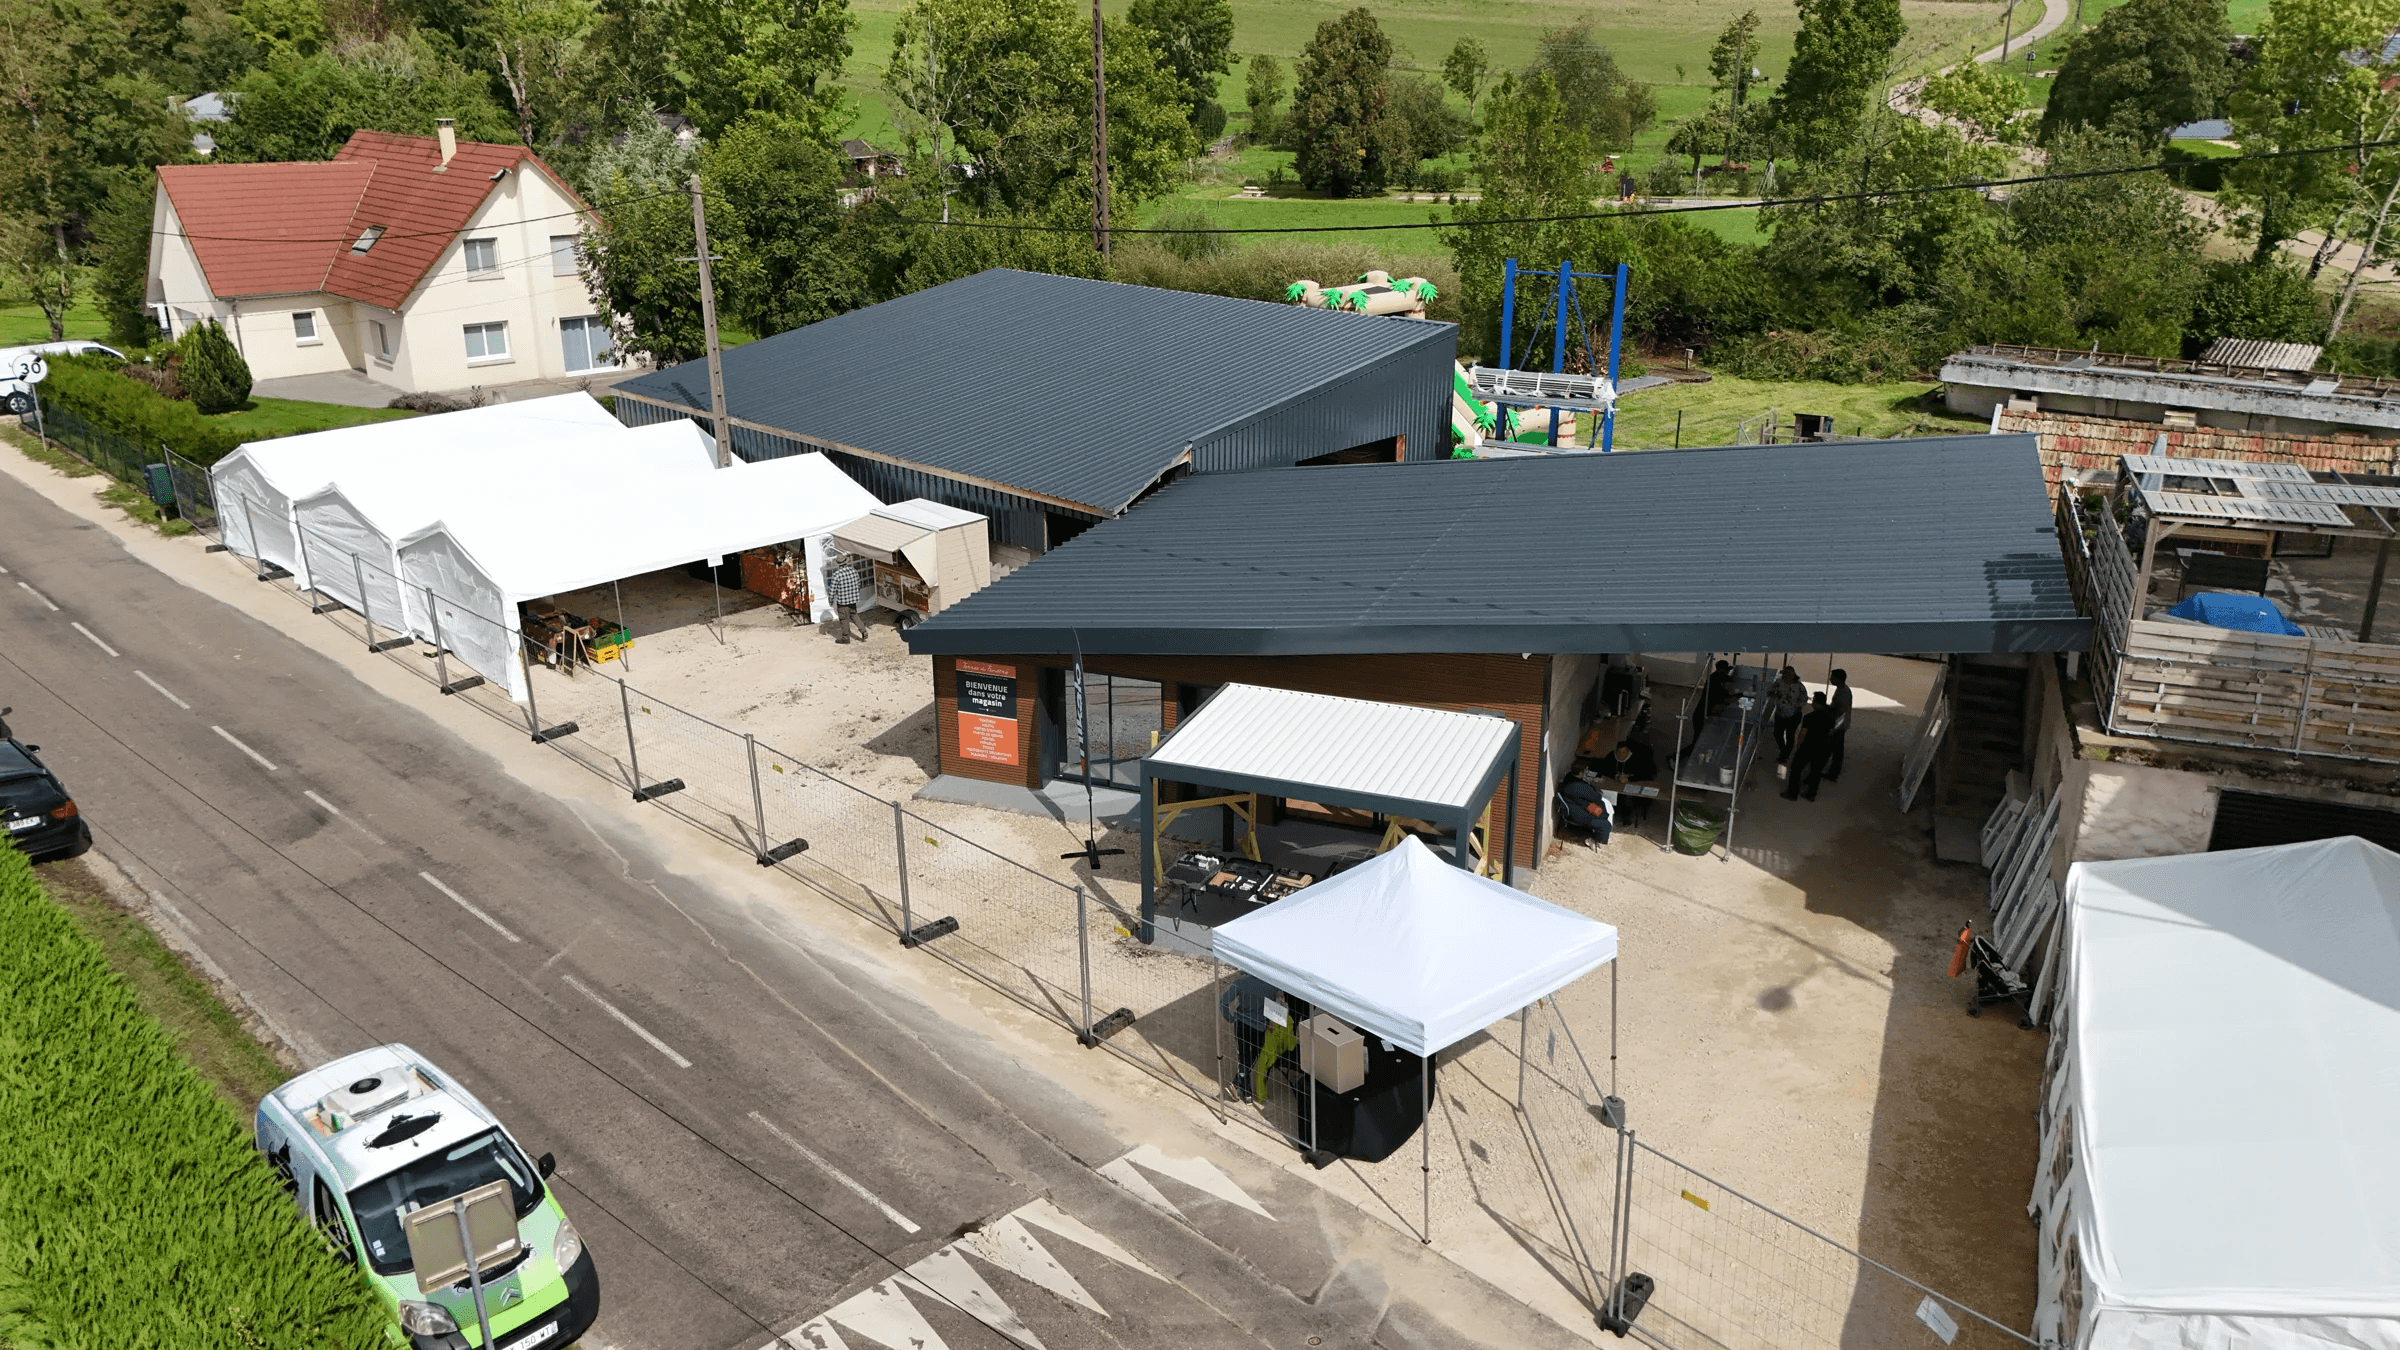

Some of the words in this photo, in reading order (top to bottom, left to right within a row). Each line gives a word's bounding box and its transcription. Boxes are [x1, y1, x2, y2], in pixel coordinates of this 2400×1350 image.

[21, 362, 41, 374] 30
[965, 680, 1008, 693] BIENVENUE
[968, 689, 985, 697] dans
[987, 692, 1006, 700] votre
[972, 698, 1002, 707] magasin
[520, 1335, 536, 1349] 150
